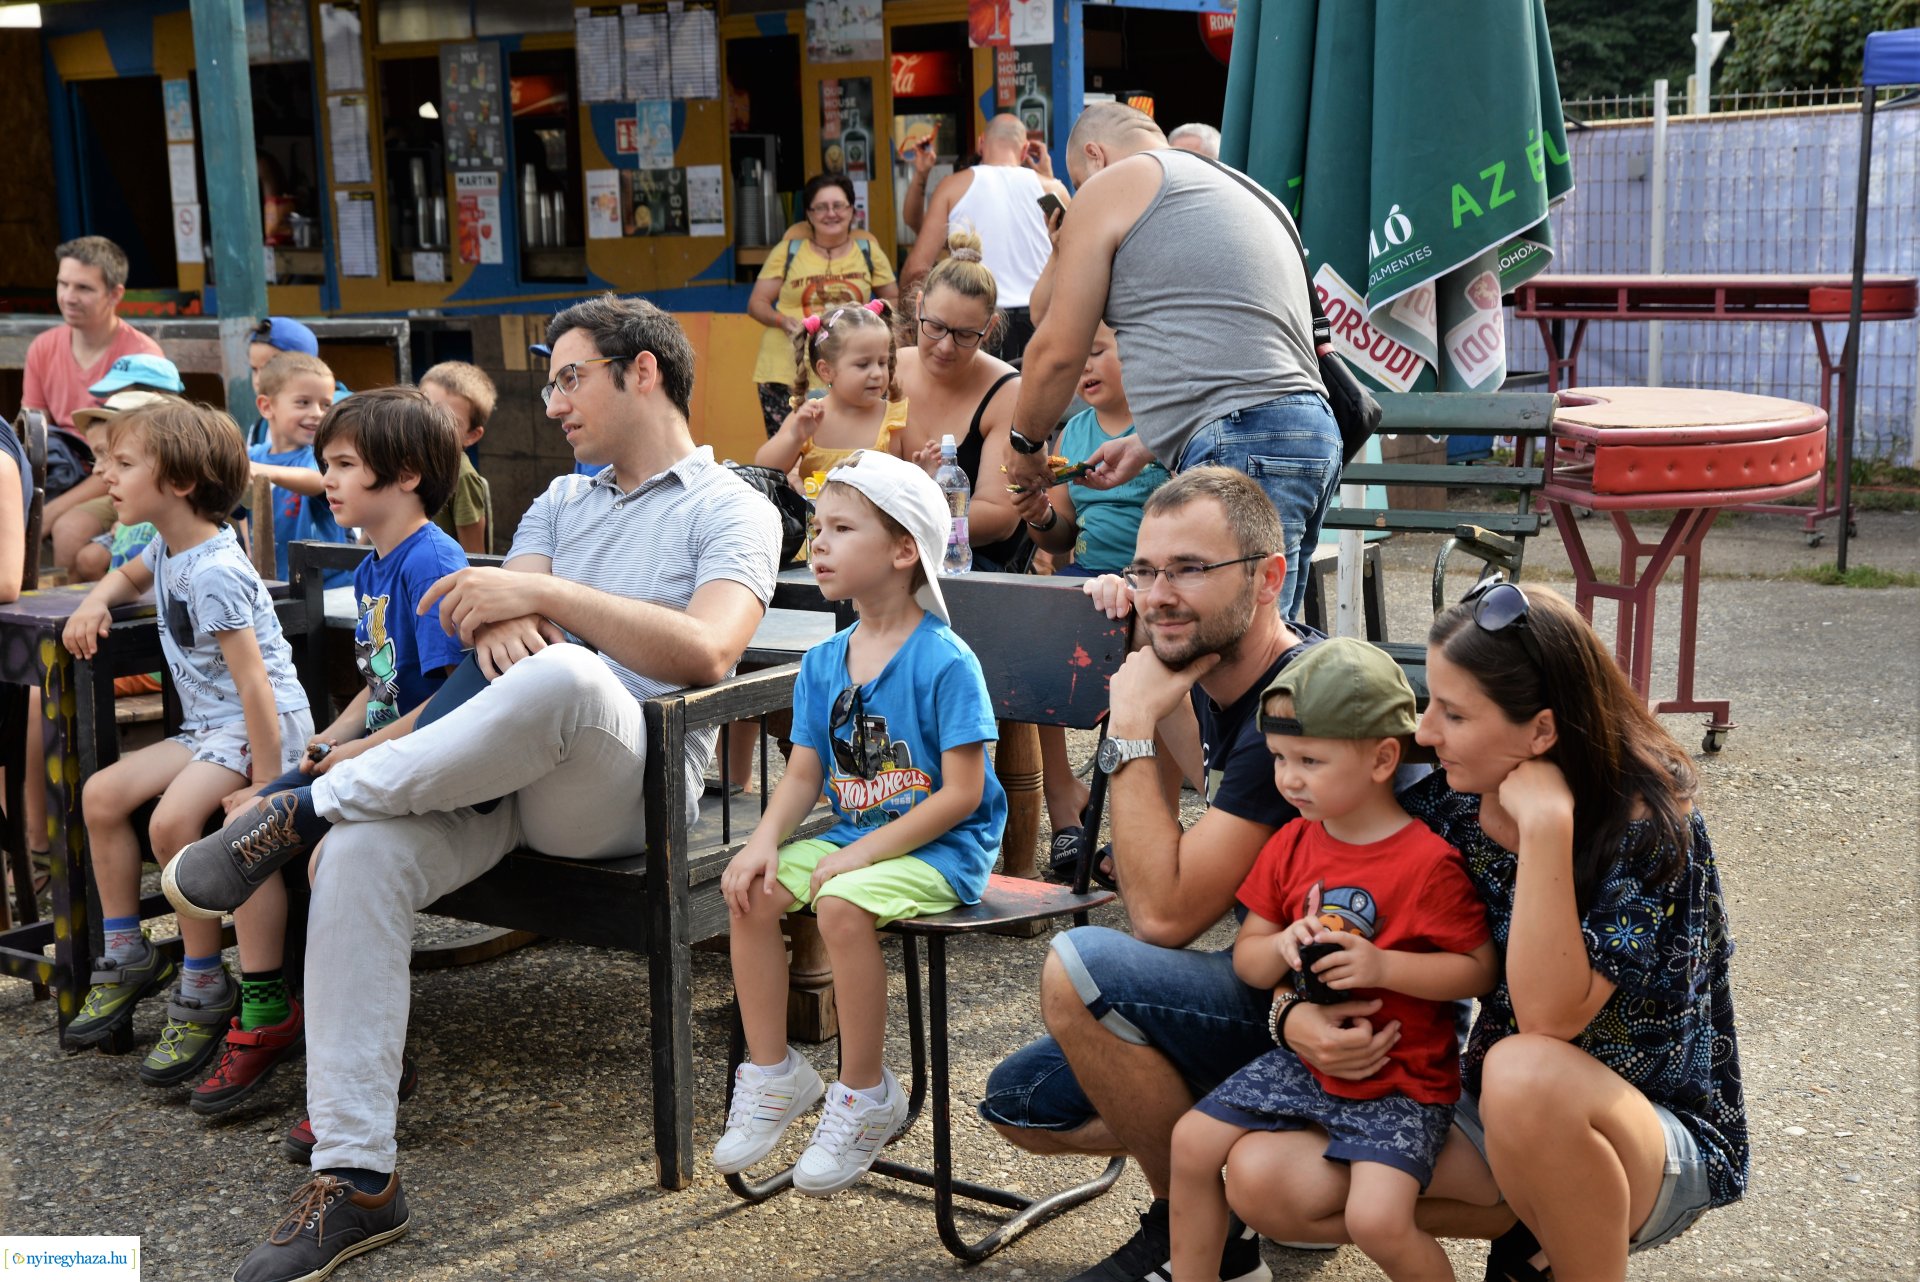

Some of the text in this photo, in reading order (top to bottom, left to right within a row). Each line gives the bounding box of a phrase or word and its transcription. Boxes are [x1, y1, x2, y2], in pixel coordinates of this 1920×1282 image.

[999, 51, 1020, 61] OUR
[999, 62, 1034, 75] HOUSE
[999, 75, 1027, 86] WINE
[823, 86, 844, 97] OUR
[1000, 89, 1010, 99] IS
[823, 97, 857, 109] HOUSE
[824, 108, 850, 120] WINE
[457, 174, 498, 188] MARTINI
[1452, 160, 1517, 229] AZ
[1054, 847, 1078, 861] umbro
